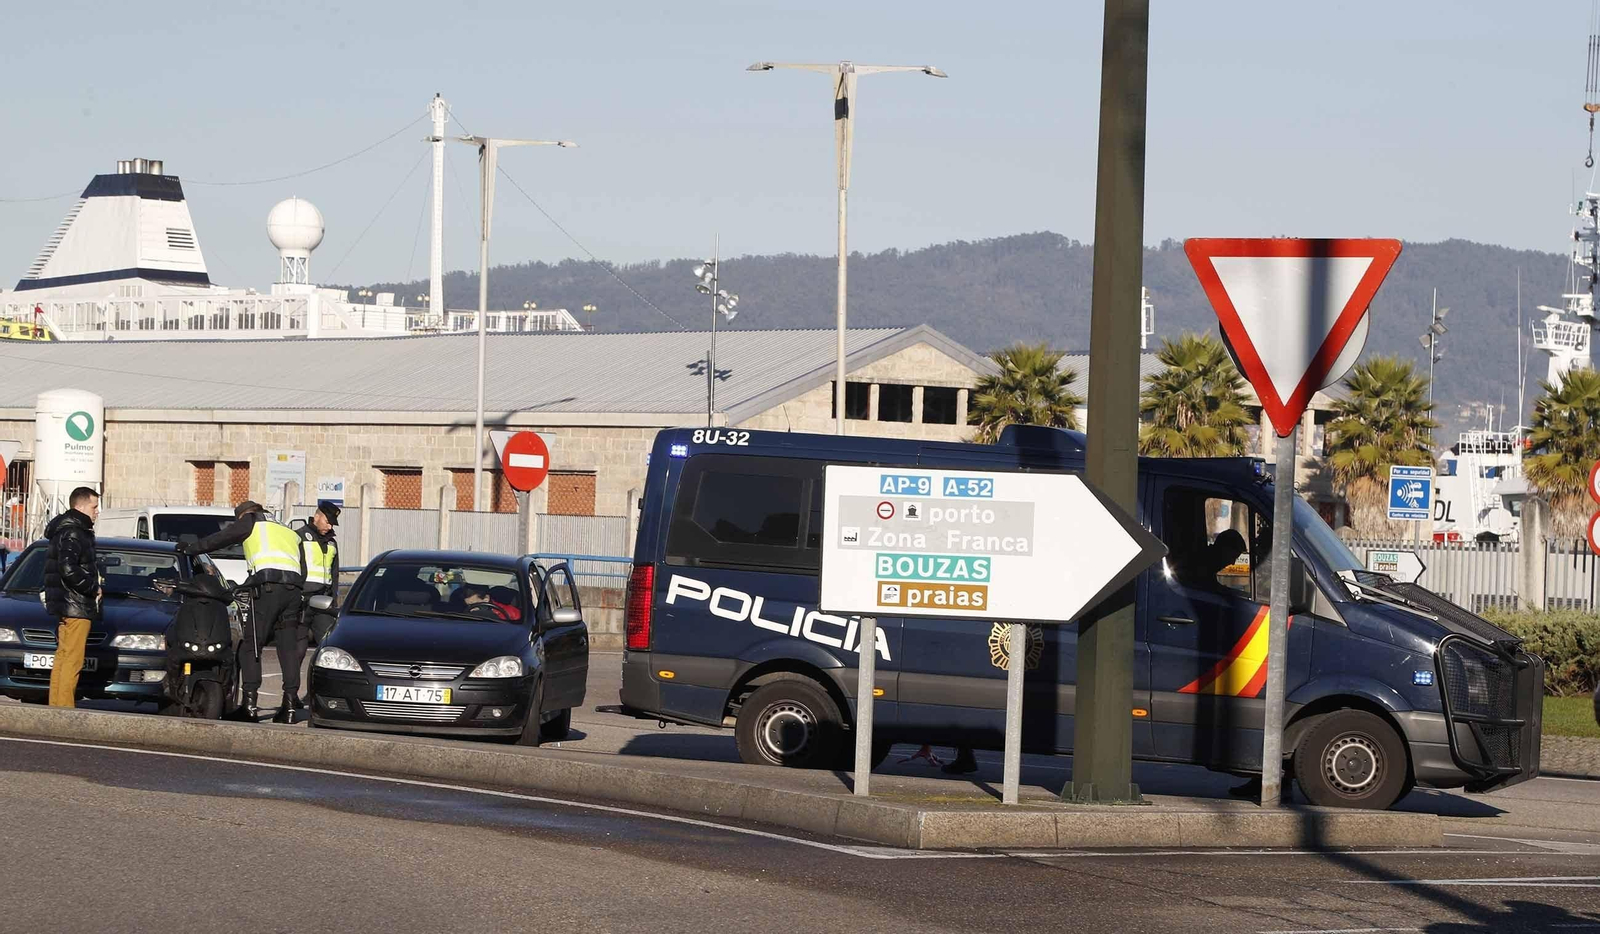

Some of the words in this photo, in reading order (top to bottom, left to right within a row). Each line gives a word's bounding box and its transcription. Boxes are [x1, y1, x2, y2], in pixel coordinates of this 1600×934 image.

[64, 443, 94, 451] Pulmor
[692, 429, 750, 446] 8U-32
[882, 476, 930, 495] AP-9
[944, 478, 992, 496] A-52
[929, 504, 995, 525] porto
[867, 527, 927, 549] Zona
[946, 529, 1029, 553] Franca
[877, 556, 989, 579] BOUZAS
[907, 586, 985, 607] praias
